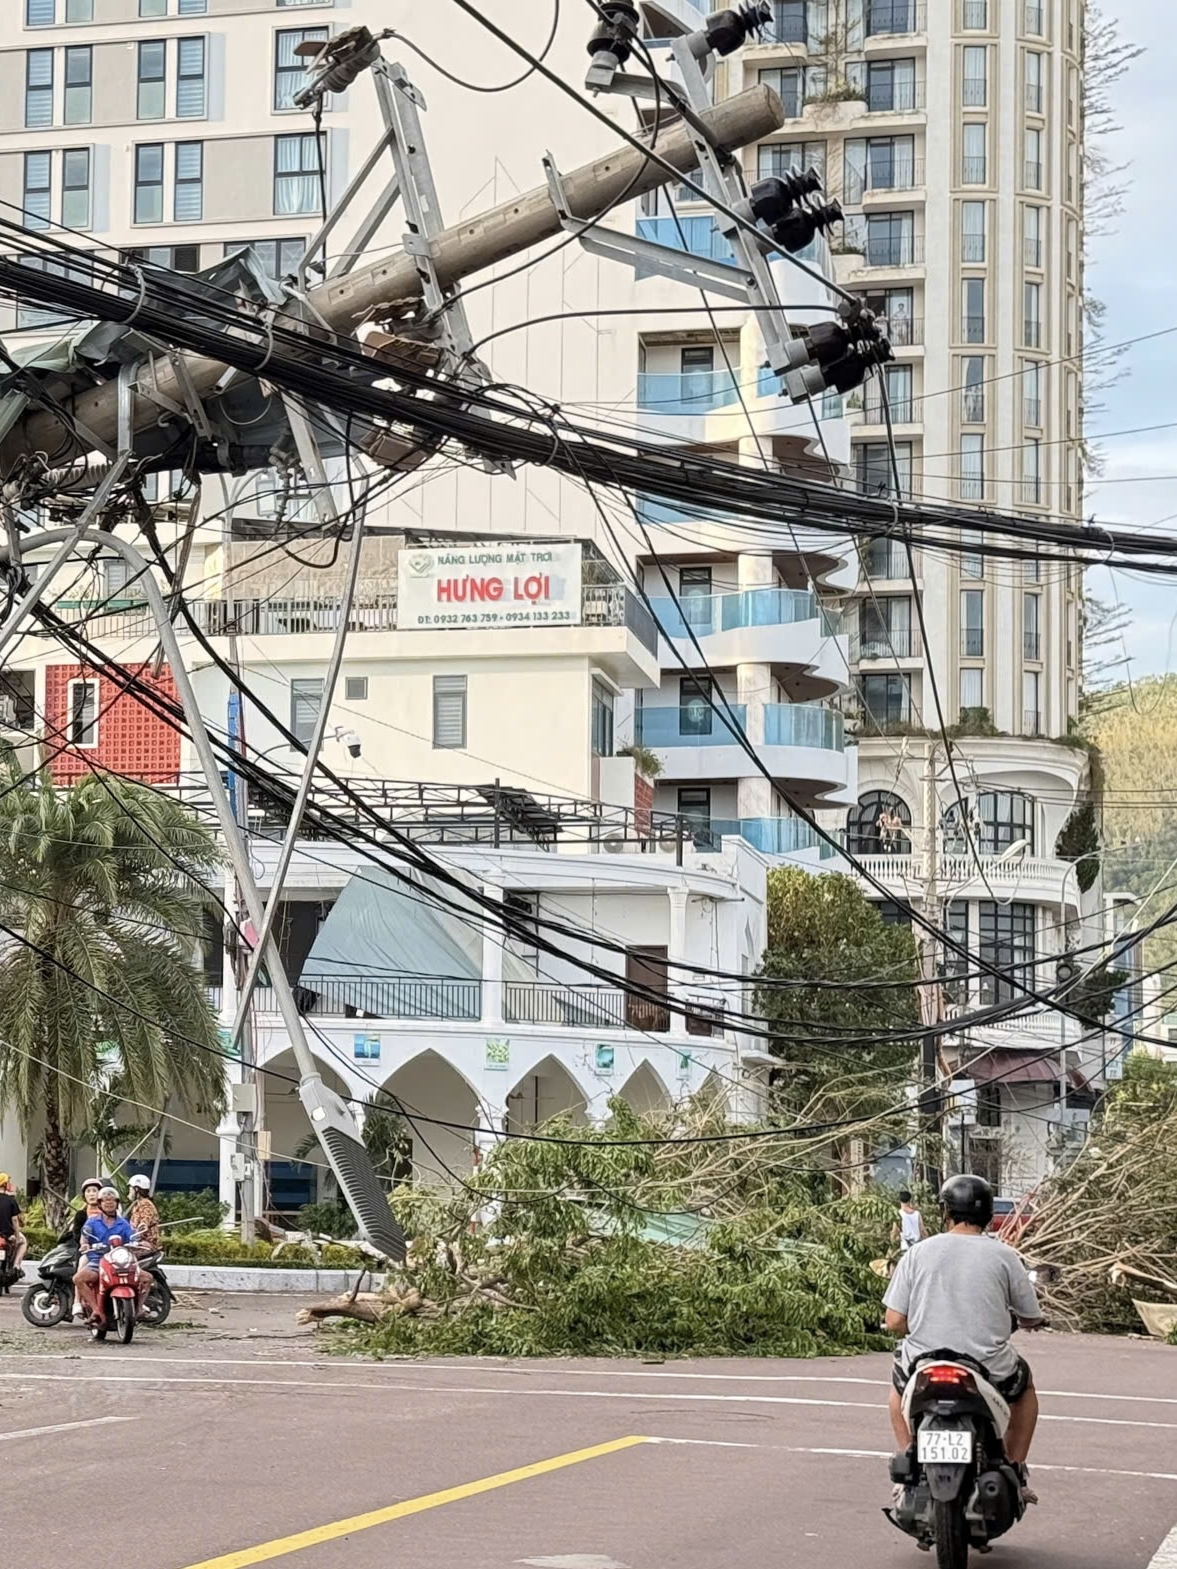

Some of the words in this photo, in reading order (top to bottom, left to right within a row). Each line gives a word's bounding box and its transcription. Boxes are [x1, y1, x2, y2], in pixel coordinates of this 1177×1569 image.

[436, 574, 504, 603] HƯNG
[513, 572, 550, 605] LỢI
[433, 614, 458, 624] 0932
[505, 612, 531, 622] 0934
[551, 611, 570, 620] 233
